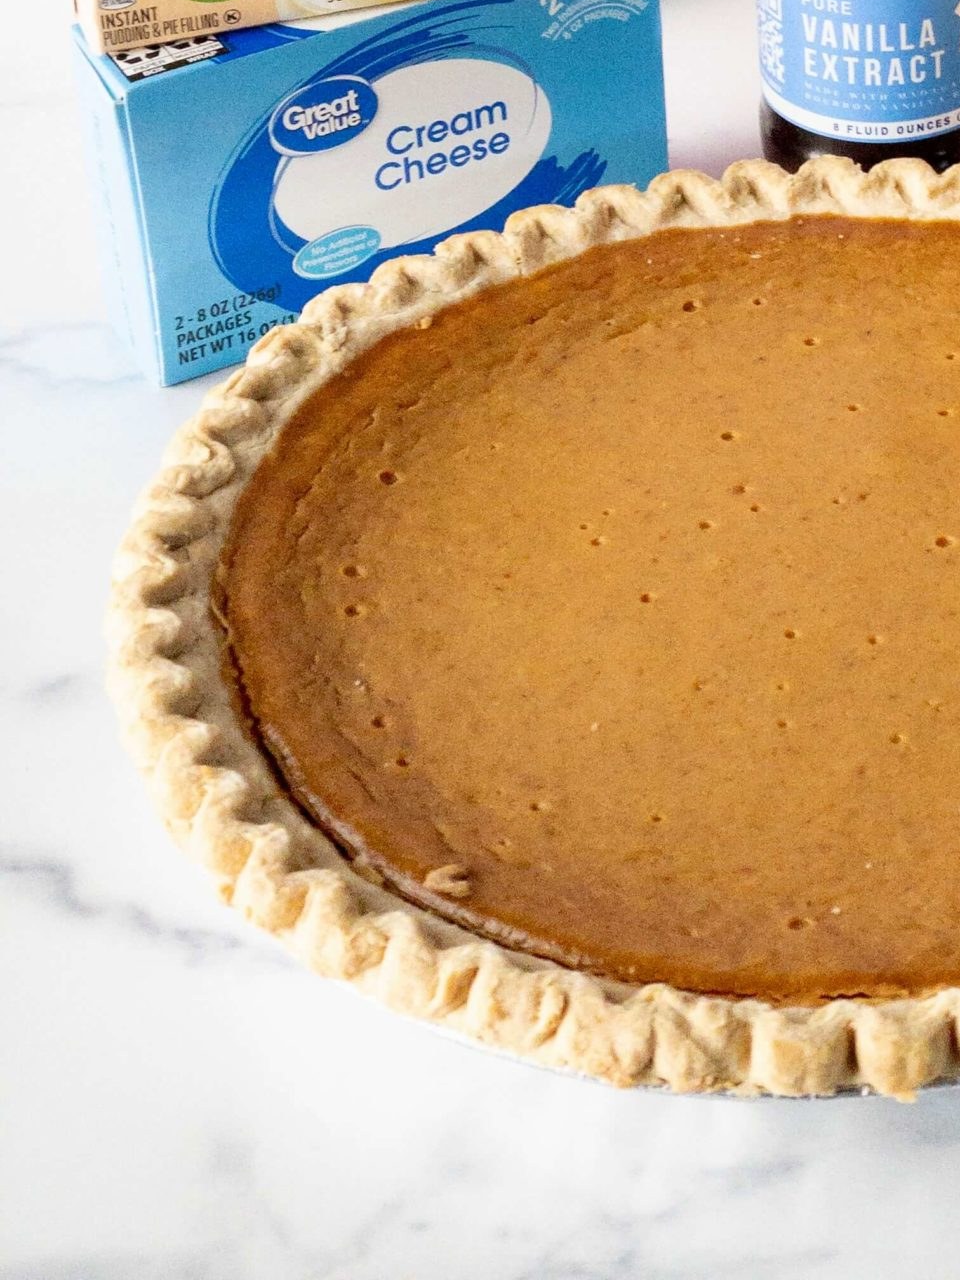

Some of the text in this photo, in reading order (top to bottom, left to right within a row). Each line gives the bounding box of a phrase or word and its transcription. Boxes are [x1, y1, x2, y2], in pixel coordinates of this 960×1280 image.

[100, 6, 158, 30] INSTANT
[103, 12, 220, 47] PUDDING & PIE FILLING
[800, 12, 937, 53] VANILLA
[804, 50, 945, 87] EXTRACT
[282, 90, 360, 130] Great
[304, 113, 362, 140] Value
[386, 101, 508, 155] Cream
[846, 125, 889, 137] FLUID
[897, 117, 951, 135] OUNCES
[375, 132, 511, 191] Cheese
[210, 299, 230, 318] OZ
[177, 310, 252, 348] PACKAGES
[178, 328, 256, 365] NET WT 16
